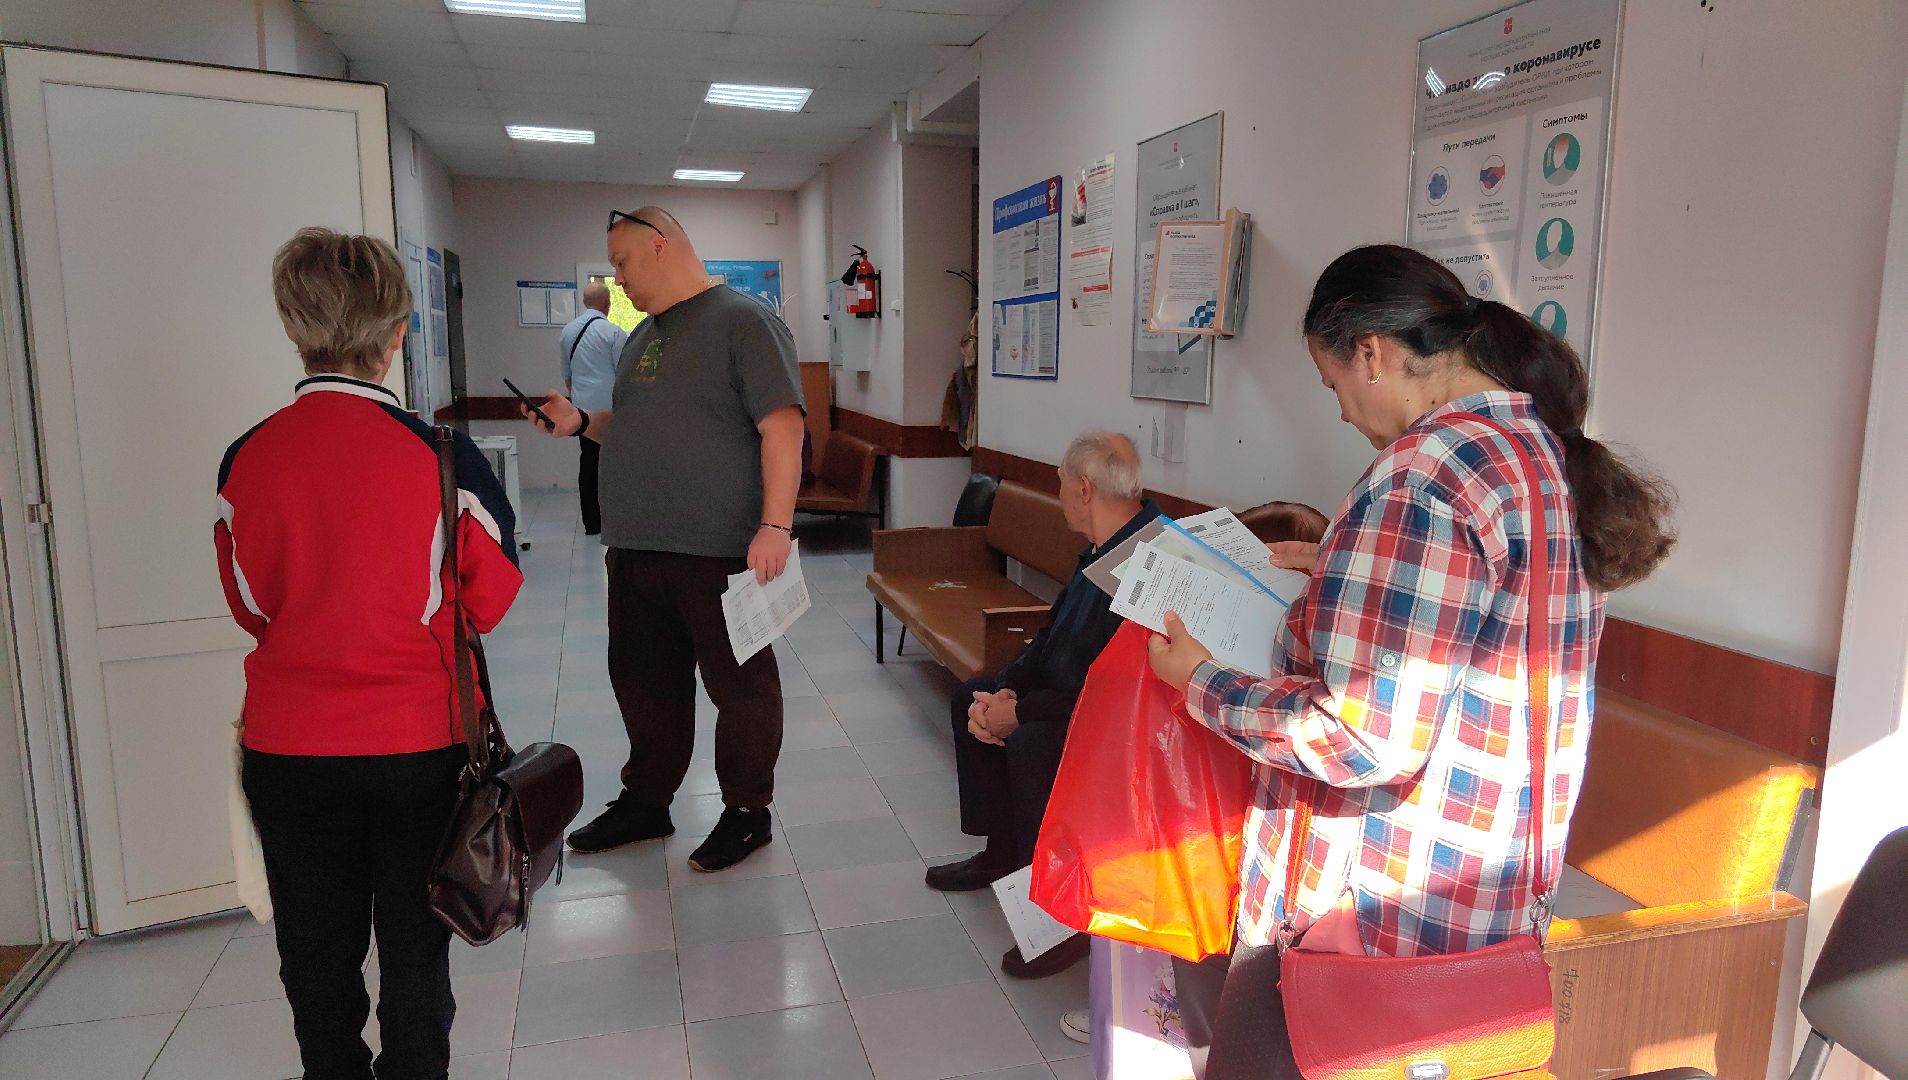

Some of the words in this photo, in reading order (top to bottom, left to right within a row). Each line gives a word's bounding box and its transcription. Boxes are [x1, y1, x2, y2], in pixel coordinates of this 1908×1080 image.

[1445, 79, 1470, 94] надо
[1504, 66, 1511, 76] о
[1513, 38, 1602, 73] коронавирусе
[1542, 112, 1588, 129] Симптомы
[1442, 143, 1460, 153] Пути
[1461, 133, 1496, 148] передачи
[1454, 253, 1490, 265] допустить
